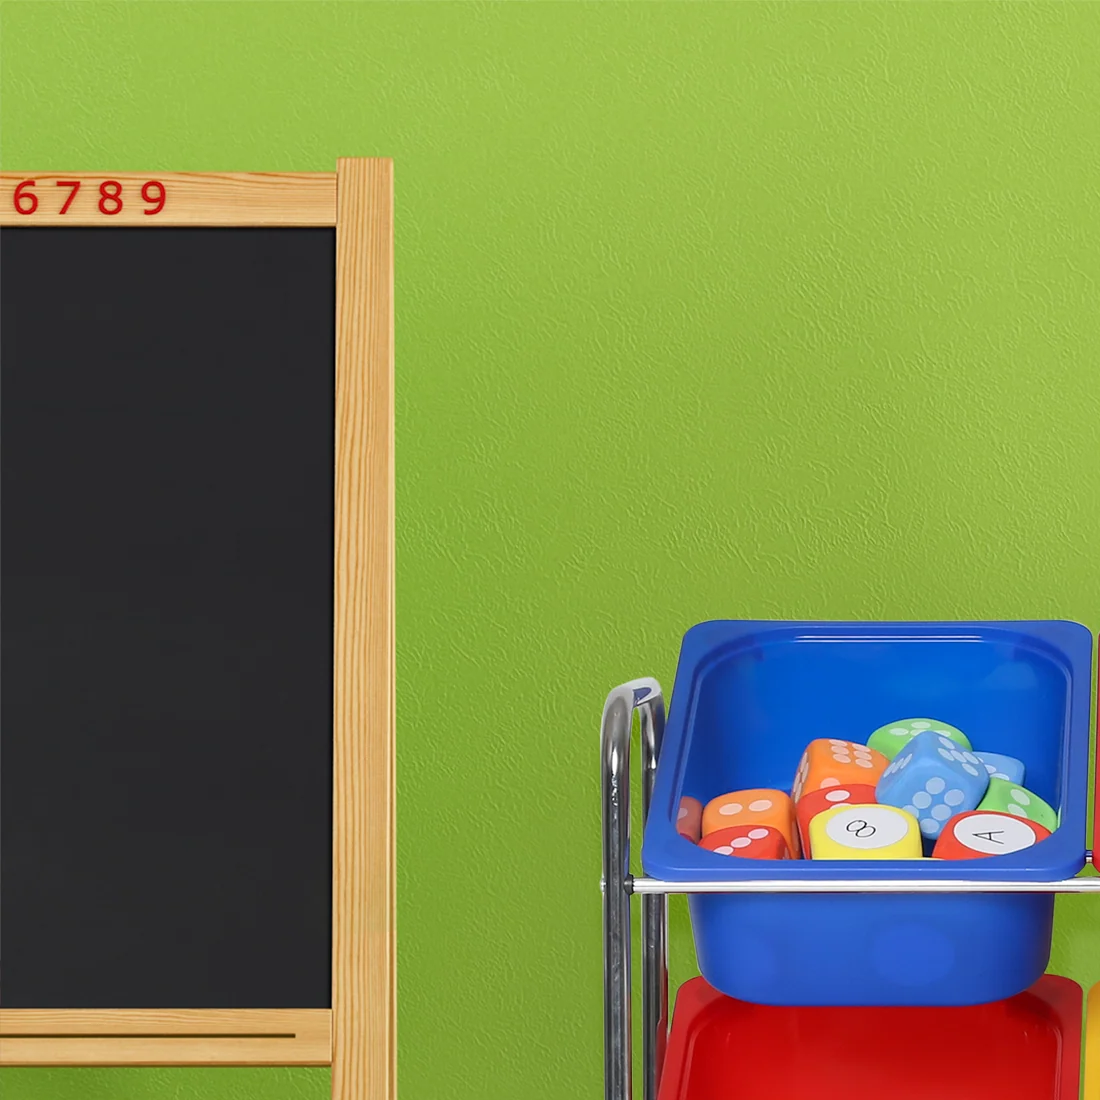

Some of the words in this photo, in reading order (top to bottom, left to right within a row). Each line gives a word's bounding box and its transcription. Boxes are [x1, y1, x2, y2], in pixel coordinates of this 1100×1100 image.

[13, 180, 38, 215] 6
[56, 181, 81, 215] 7
[98, 180, 123, 216] 8
[141, 180, 166, 216] 9
[972, 830, 1005, 844] A
